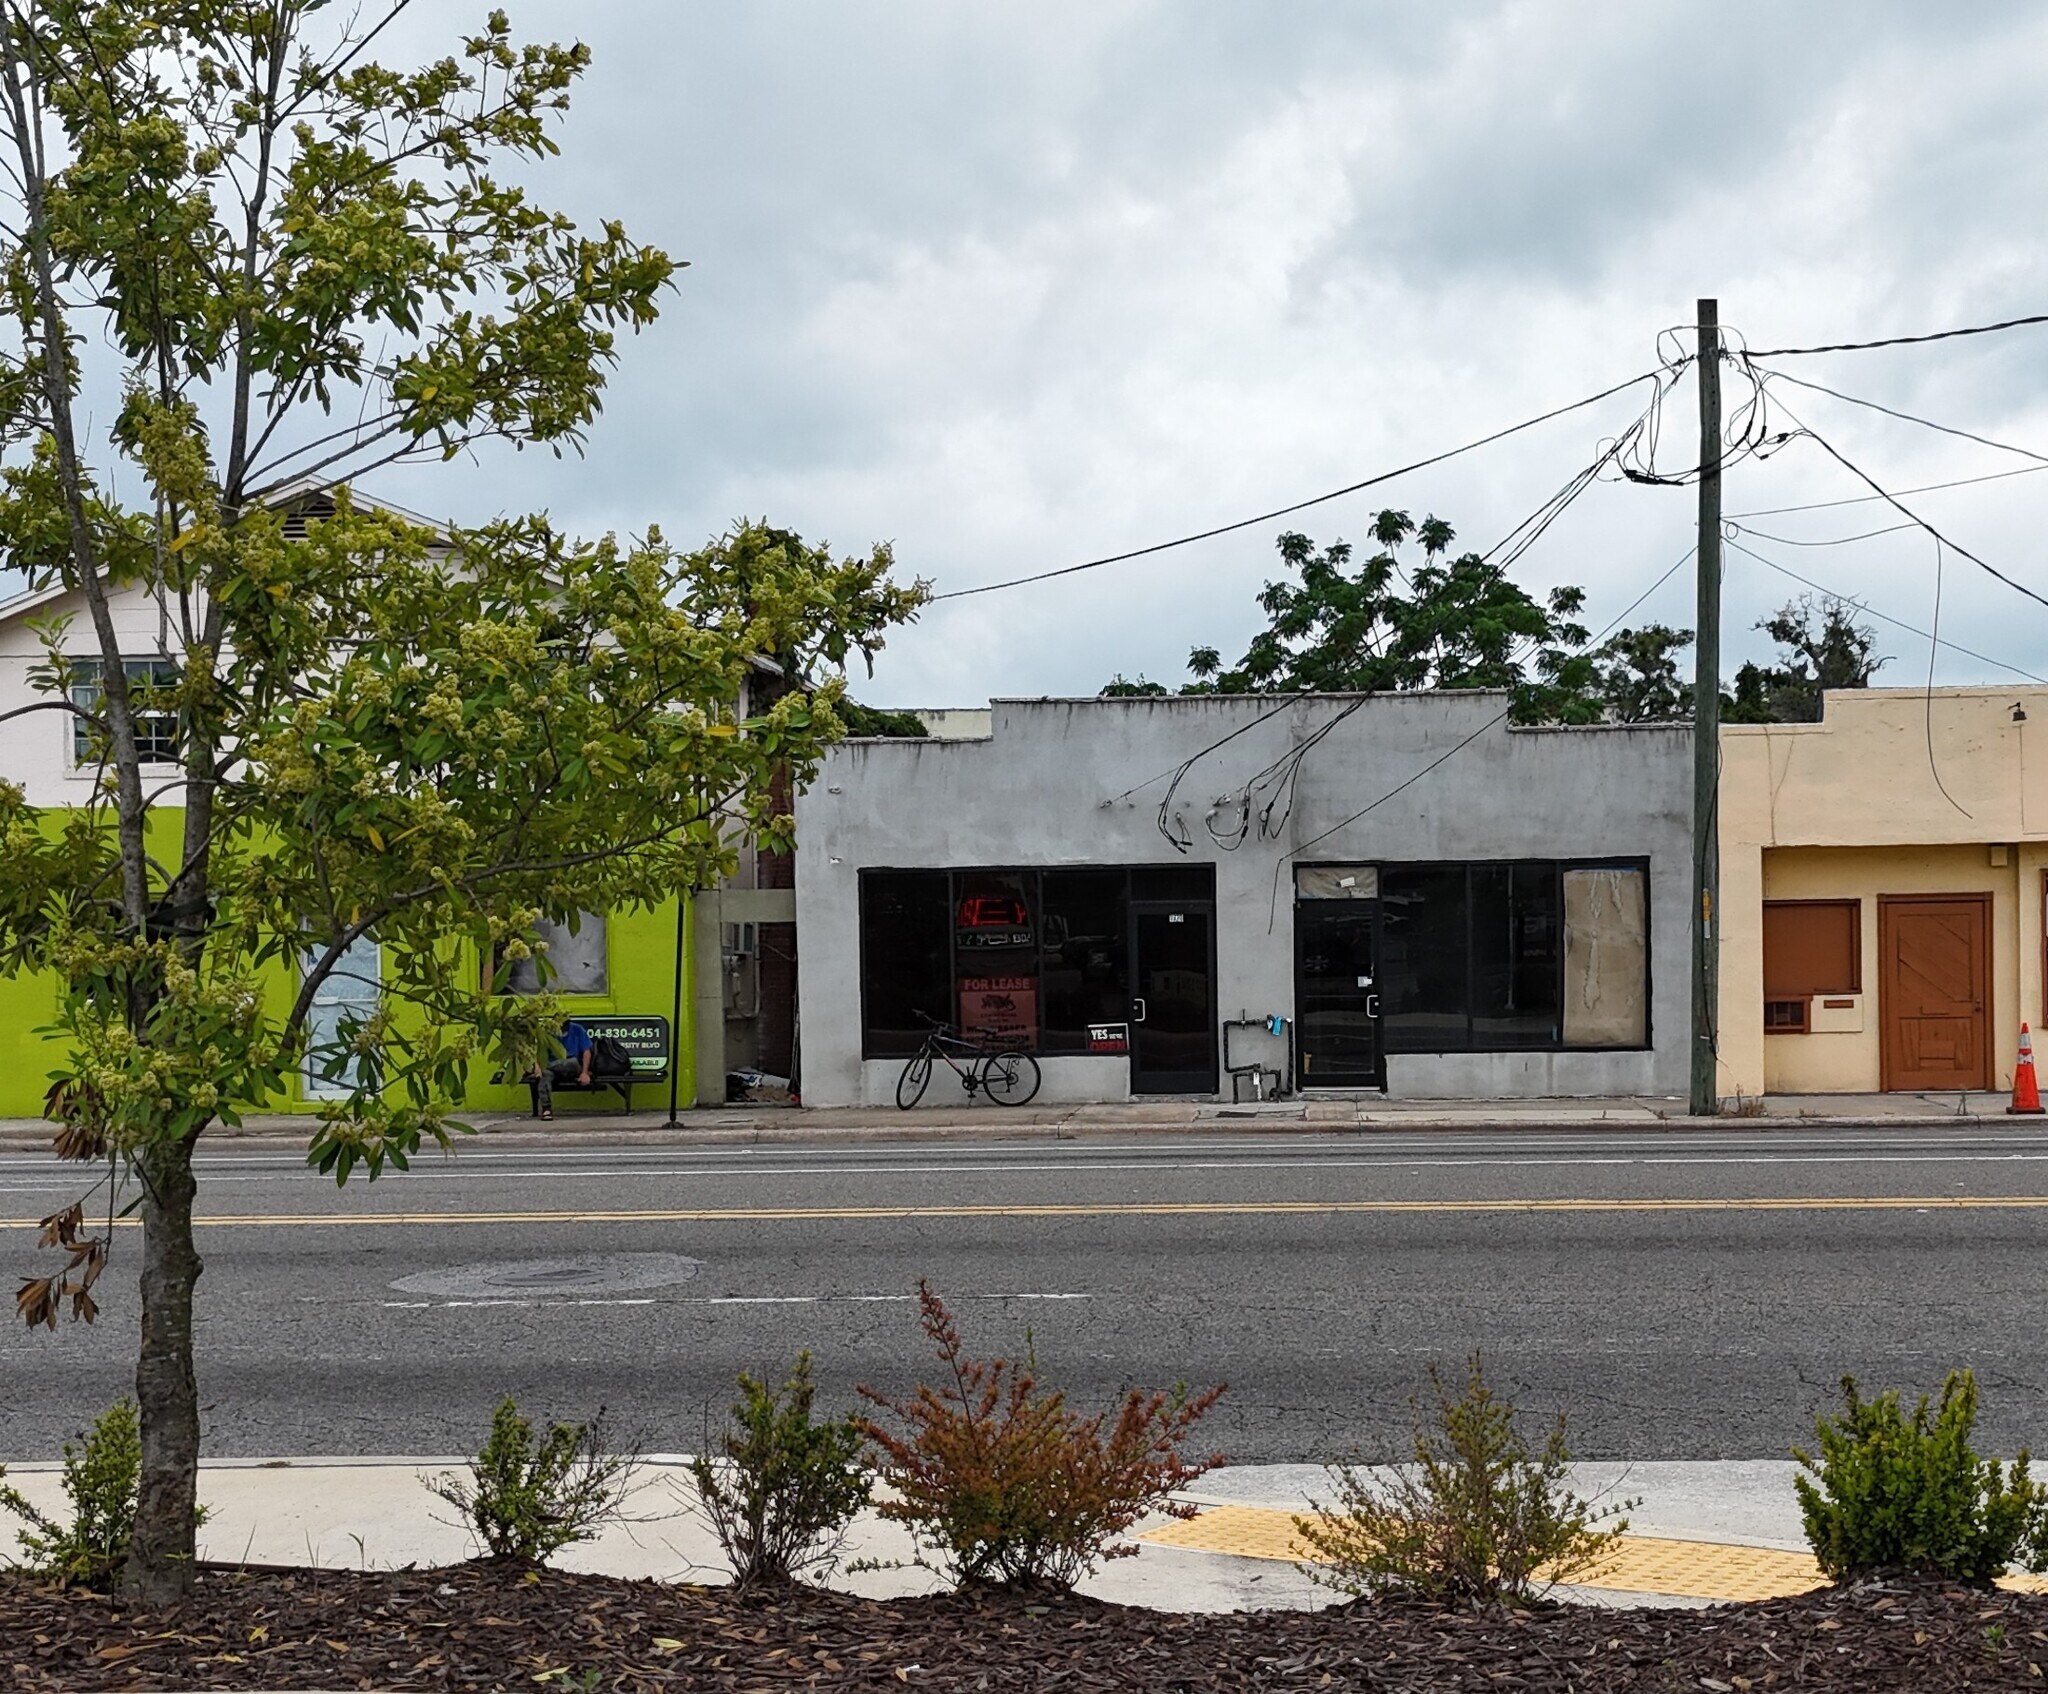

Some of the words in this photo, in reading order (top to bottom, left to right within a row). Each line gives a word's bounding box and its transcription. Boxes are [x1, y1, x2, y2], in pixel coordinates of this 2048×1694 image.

[964, 979, 989, 991] FOR
[992, 978, 1030, 990] LEASE
[587, 1028, 660, 1038] 04-830-6451
[1091, 1029, 1108, 1040] YES
